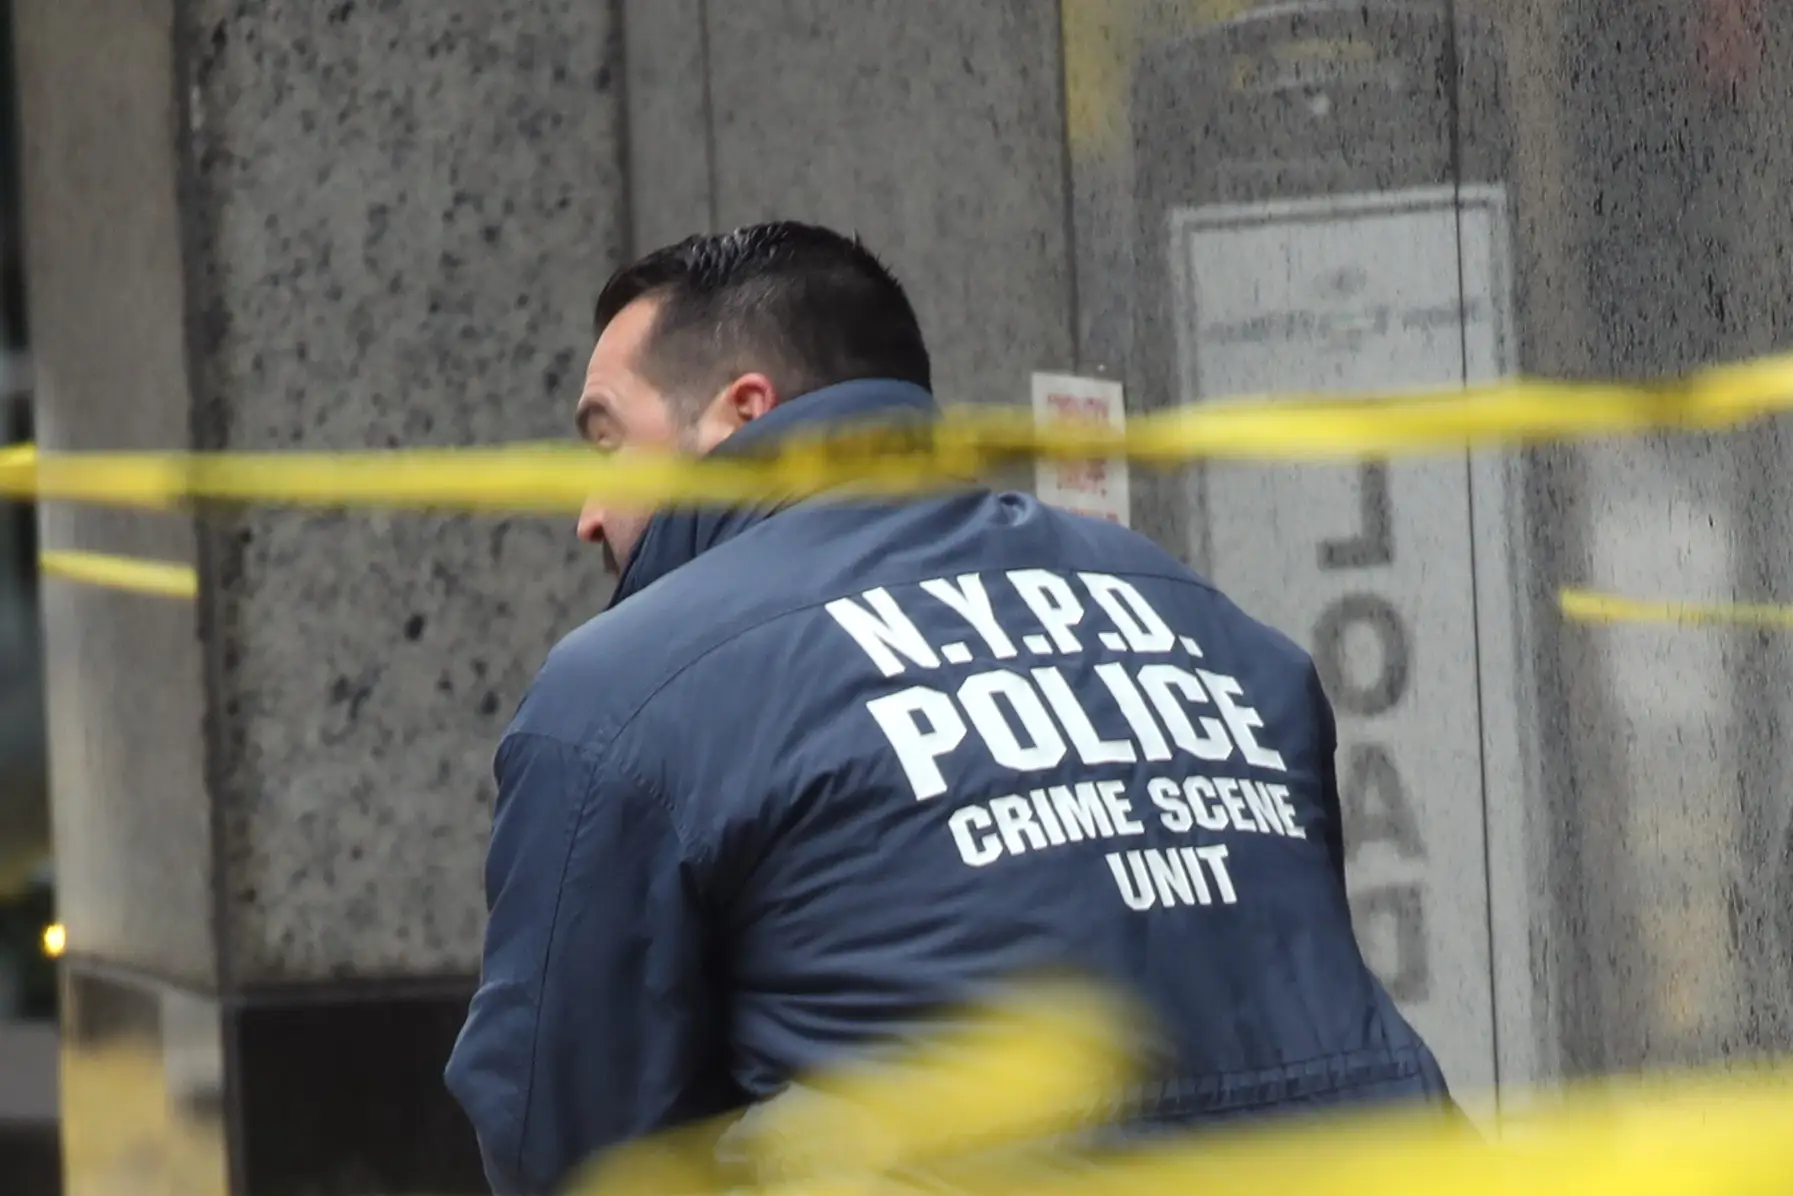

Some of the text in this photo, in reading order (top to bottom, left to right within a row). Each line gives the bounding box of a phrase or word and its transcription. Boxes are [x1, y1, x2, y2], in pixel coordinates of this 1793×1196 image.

[824, 568, 1204, 678] N.Y.P.D.
[866, 661, 1288, 801] POLICE
[948, 775, 1307, 867] CRIME SCENE
[1105, 843, 1238, 911] UNIT
